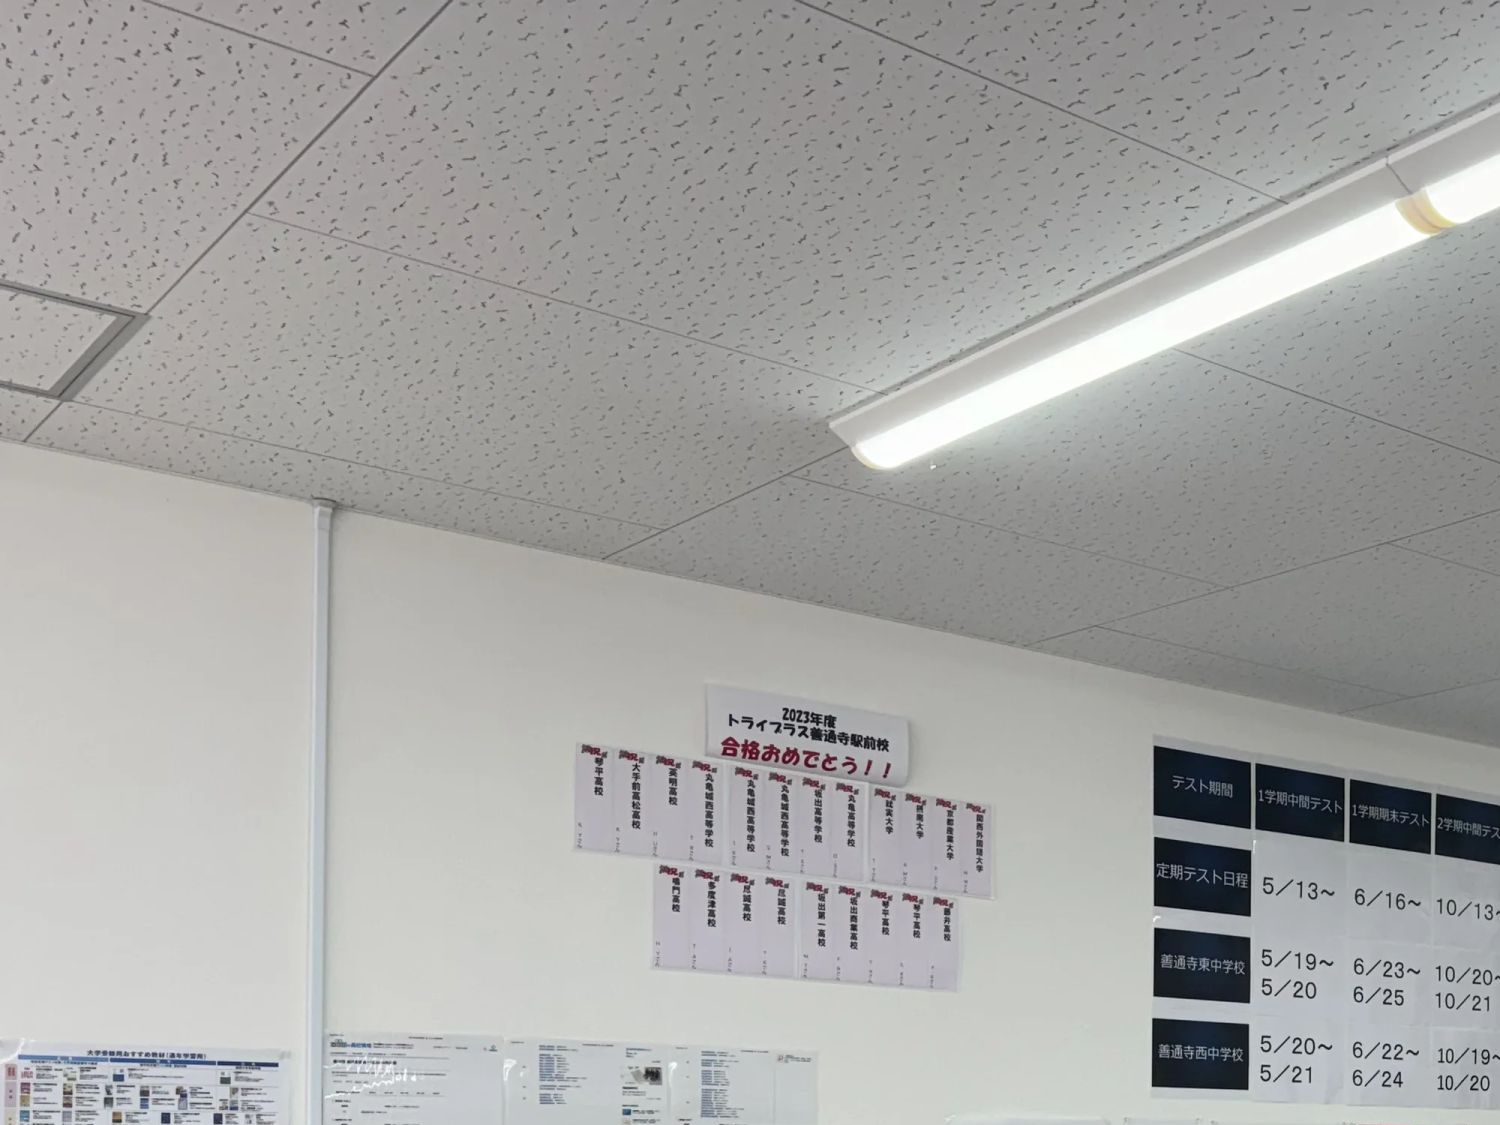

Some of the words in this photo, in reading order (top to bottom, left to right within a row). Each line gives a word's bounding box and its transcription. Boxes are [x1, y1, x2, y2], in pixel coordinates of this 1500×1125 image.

[782, 707, 837, 728] 2023年度
[728, 713, 890, 752] トライプラス善通寺駅前校
[632, 763, 641, 830] 大手前高松高校
[669, 768, 677, 806] 英明高校
[1172, 775, 1233, 798] テスト期間
[705, 773, 714, 848] 丸亀城西高等学校
[1258, 789, 1343, 814] 1学期中間テスト
[747, 779, 755, 852] 丸亀城西高等学校
[781, 785, 789, 857] 丸亀城西高等学校
[814, 789, 823, 843] 坂出高等学校
[847, 795, 856, 848] 丸亀高等学校
[1352, 804, 1430, 828] 1学期期末テスト
[1156, 862, 1249, 888] 定期テスト日程
[708, 881, 716, 927] 多度津高校
[1160, 953, 1245, 975] 善通寺東中学校
[1261, 978, 1317, 999] 5/20
[1353, 986, 1404, 1006] 6/25
[1435, 992, 1490, 1012] 10/21
[1158, 1043, 1244, 1062] 善通寺西中学校
[1260, 1064, 1312, 1084] 5/21
[1352, 1069, 1403, 1088] 6/24
[1437, 1074, 1490, 1092] 10/20
